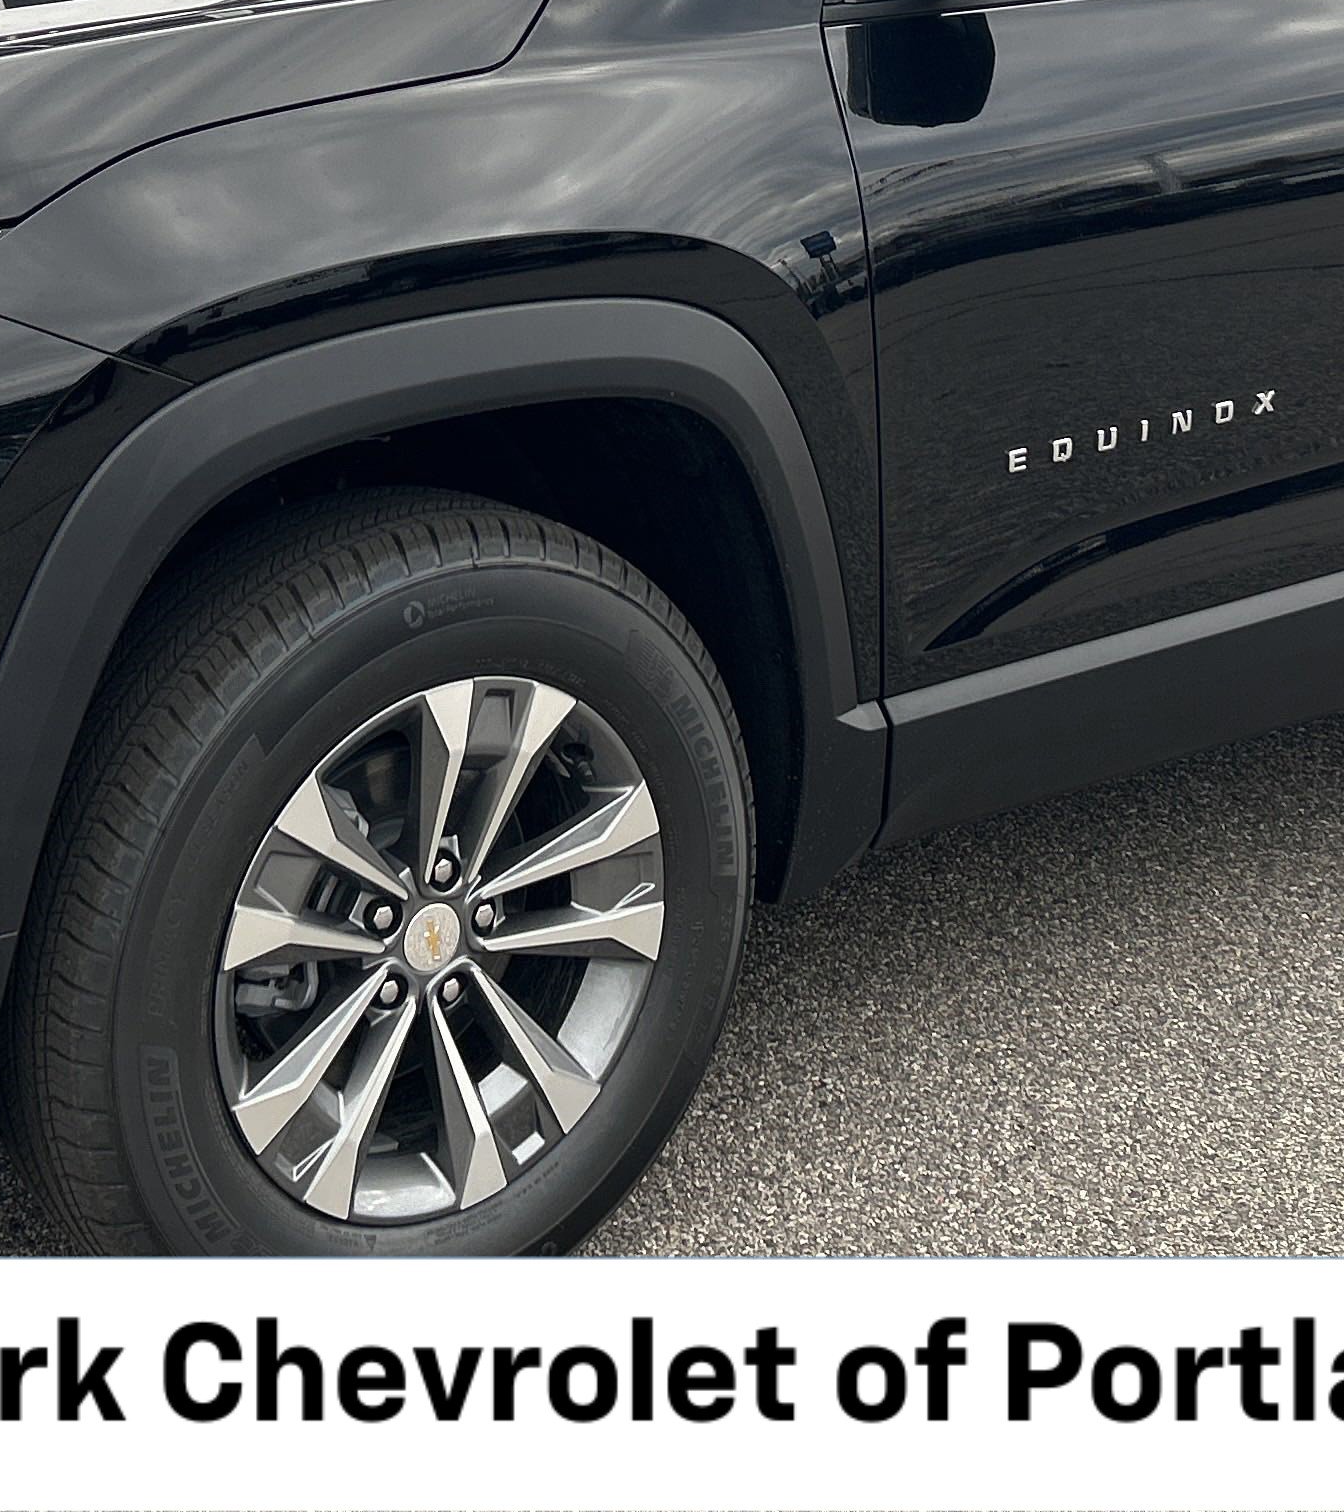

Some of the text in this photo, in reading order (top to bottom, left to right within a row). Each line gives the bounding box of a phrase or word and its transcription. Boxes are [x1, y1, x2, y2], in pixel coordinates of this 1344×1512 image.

[1007, 390, 1276, 473] EQUINOX
[670, 694, 734, 864] MICHELIN
[148, 1056, 232, 1245] MICHELIN
